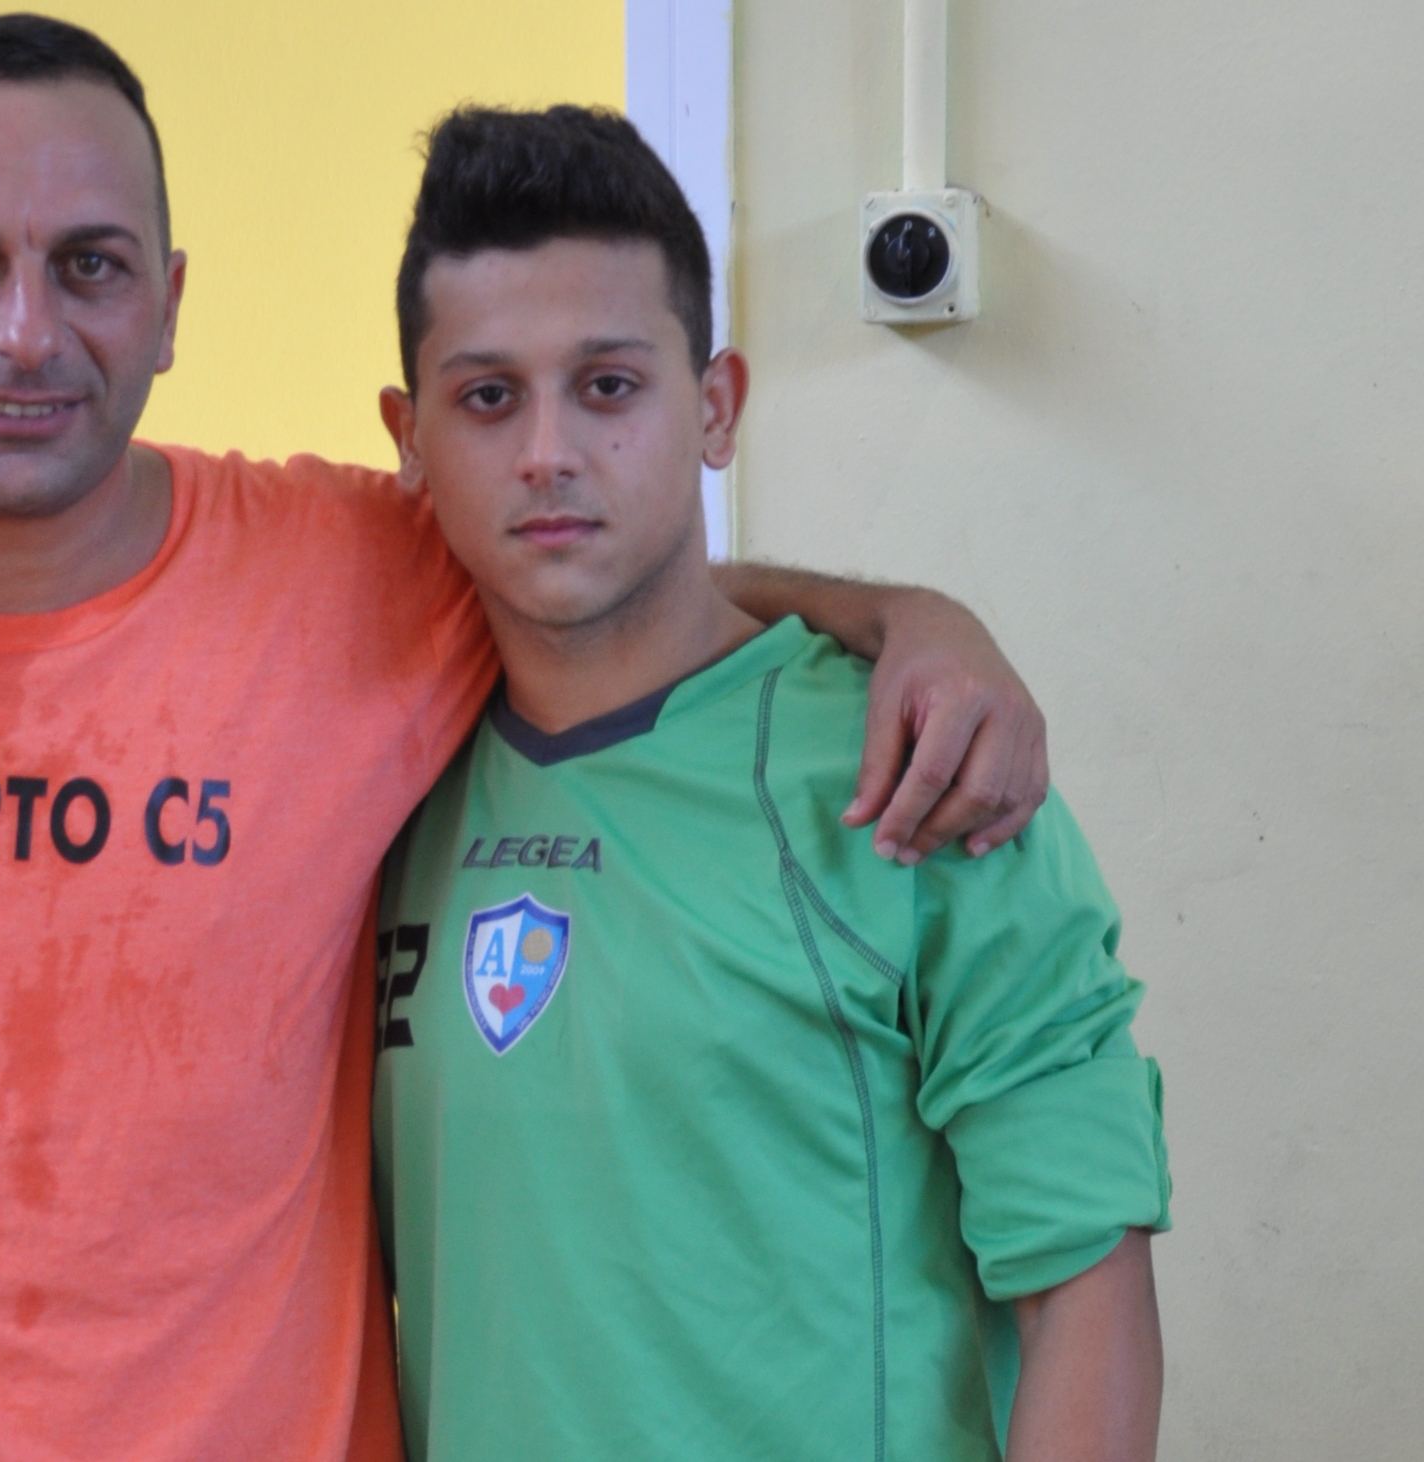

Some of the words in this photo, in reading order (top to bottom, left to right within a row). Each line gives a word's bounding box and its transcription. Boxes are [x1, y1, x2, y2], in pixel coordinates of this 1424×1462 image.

[144, 776, 232, 867] C5
[461, 834, 603, 874] LEGEA
[475, 927, 508, 978] A
